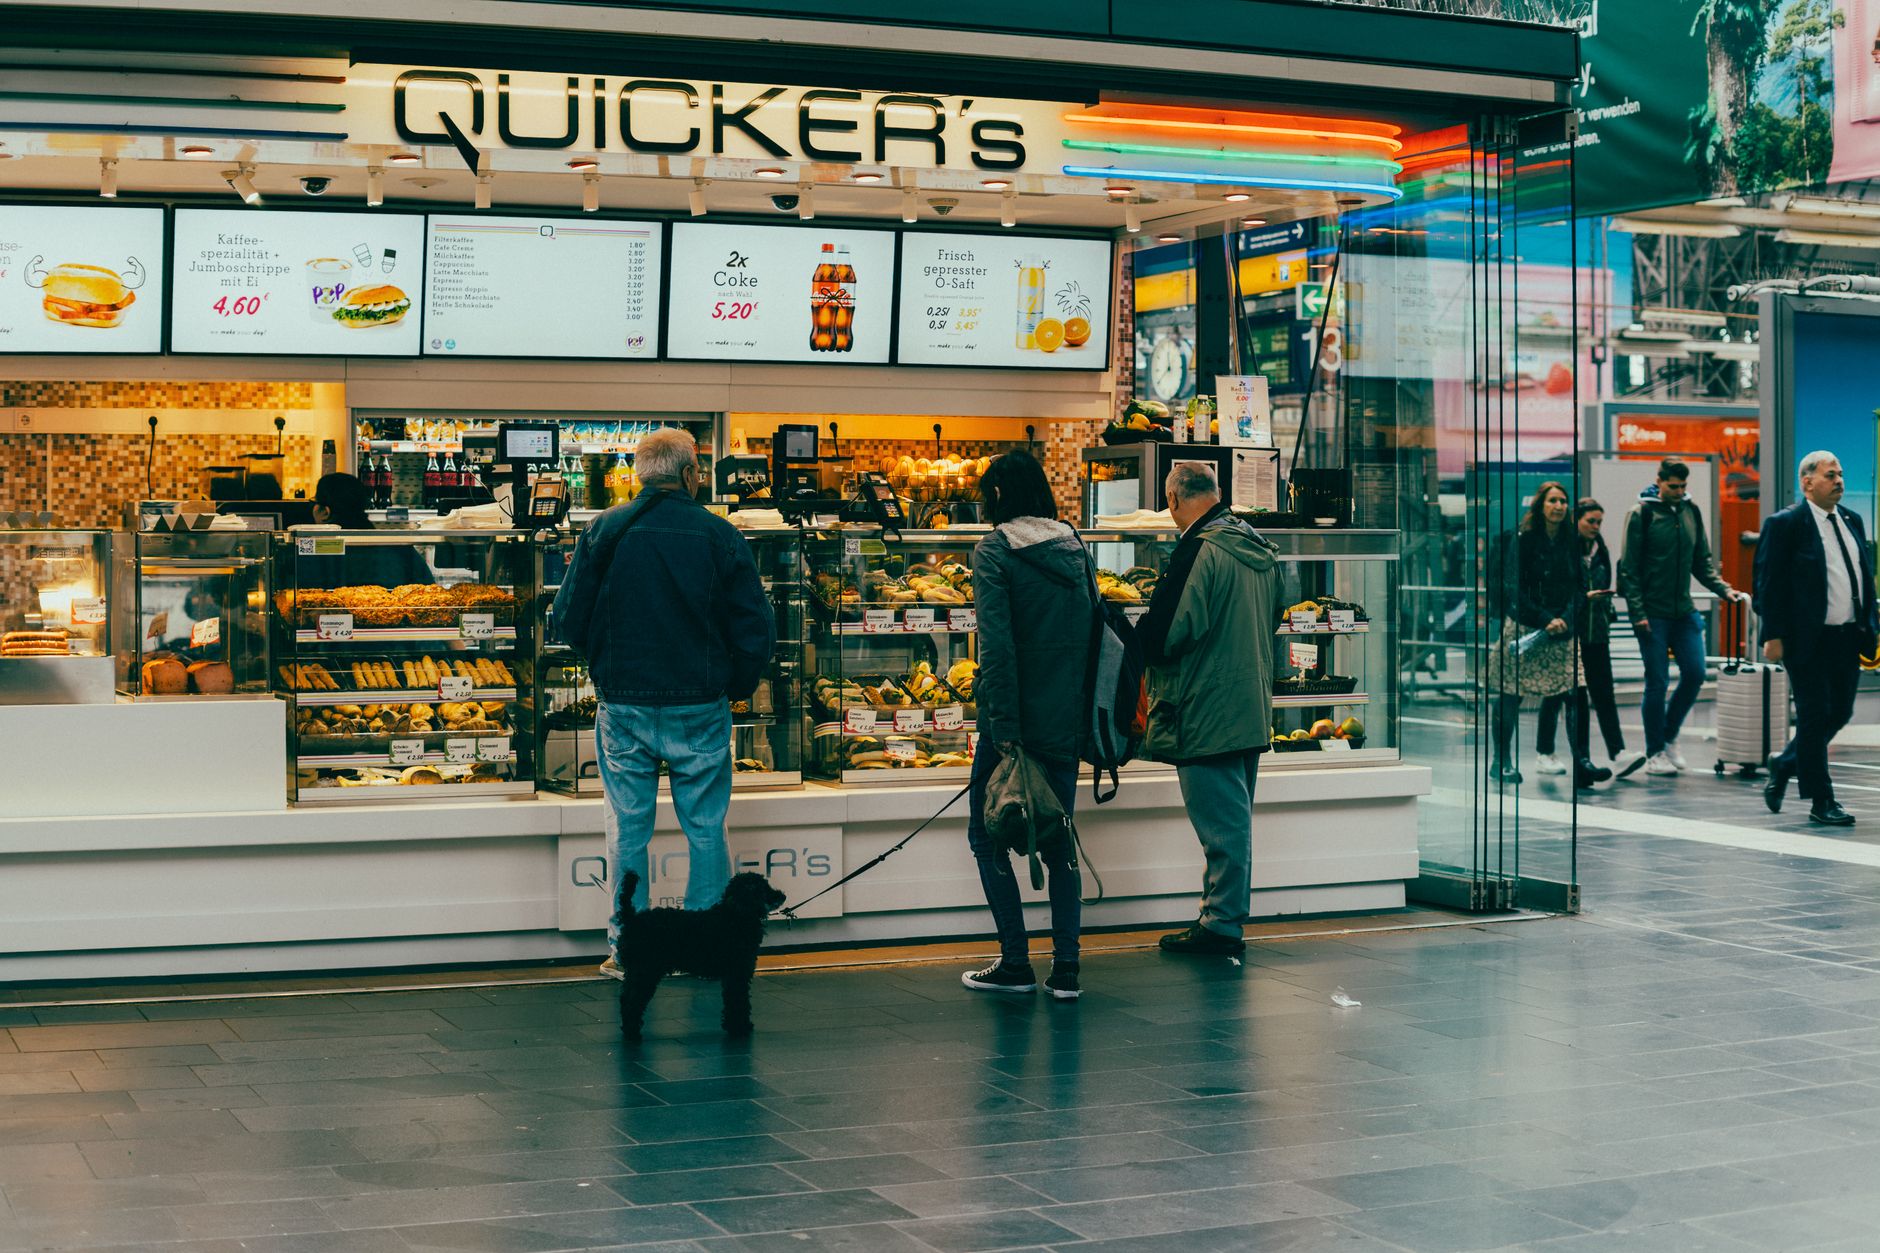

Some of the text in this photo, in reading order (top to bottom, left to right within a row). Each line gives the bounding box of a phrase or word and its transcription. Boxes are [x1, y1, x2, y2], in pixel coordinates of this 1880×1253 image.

[1587, 96, 1640, 121] verwenden
[217, 233, 264, 245] Kaffee-
[200, 248, 269, 261] spezialität
[726, 250, 749, 268] 2x
[937, 249, 975, 261] Frisch
[188, 261, 290, 276] Jumboschrippe
[923, 265, 988, 277] gepresster
[220, 276, 259, 287] mit Ei
[713, 271, 758, 287] Coke
[935, 277, 975, 289] O-Saft
[213, 291, 270, 317] 4,60€
[711, 301, 760, 321] 5,20€
[926, 306, 951, 317] 0,25l
[928, 319, 947, 331] 0,5l
[1302, 326, 1342, 372] 13
